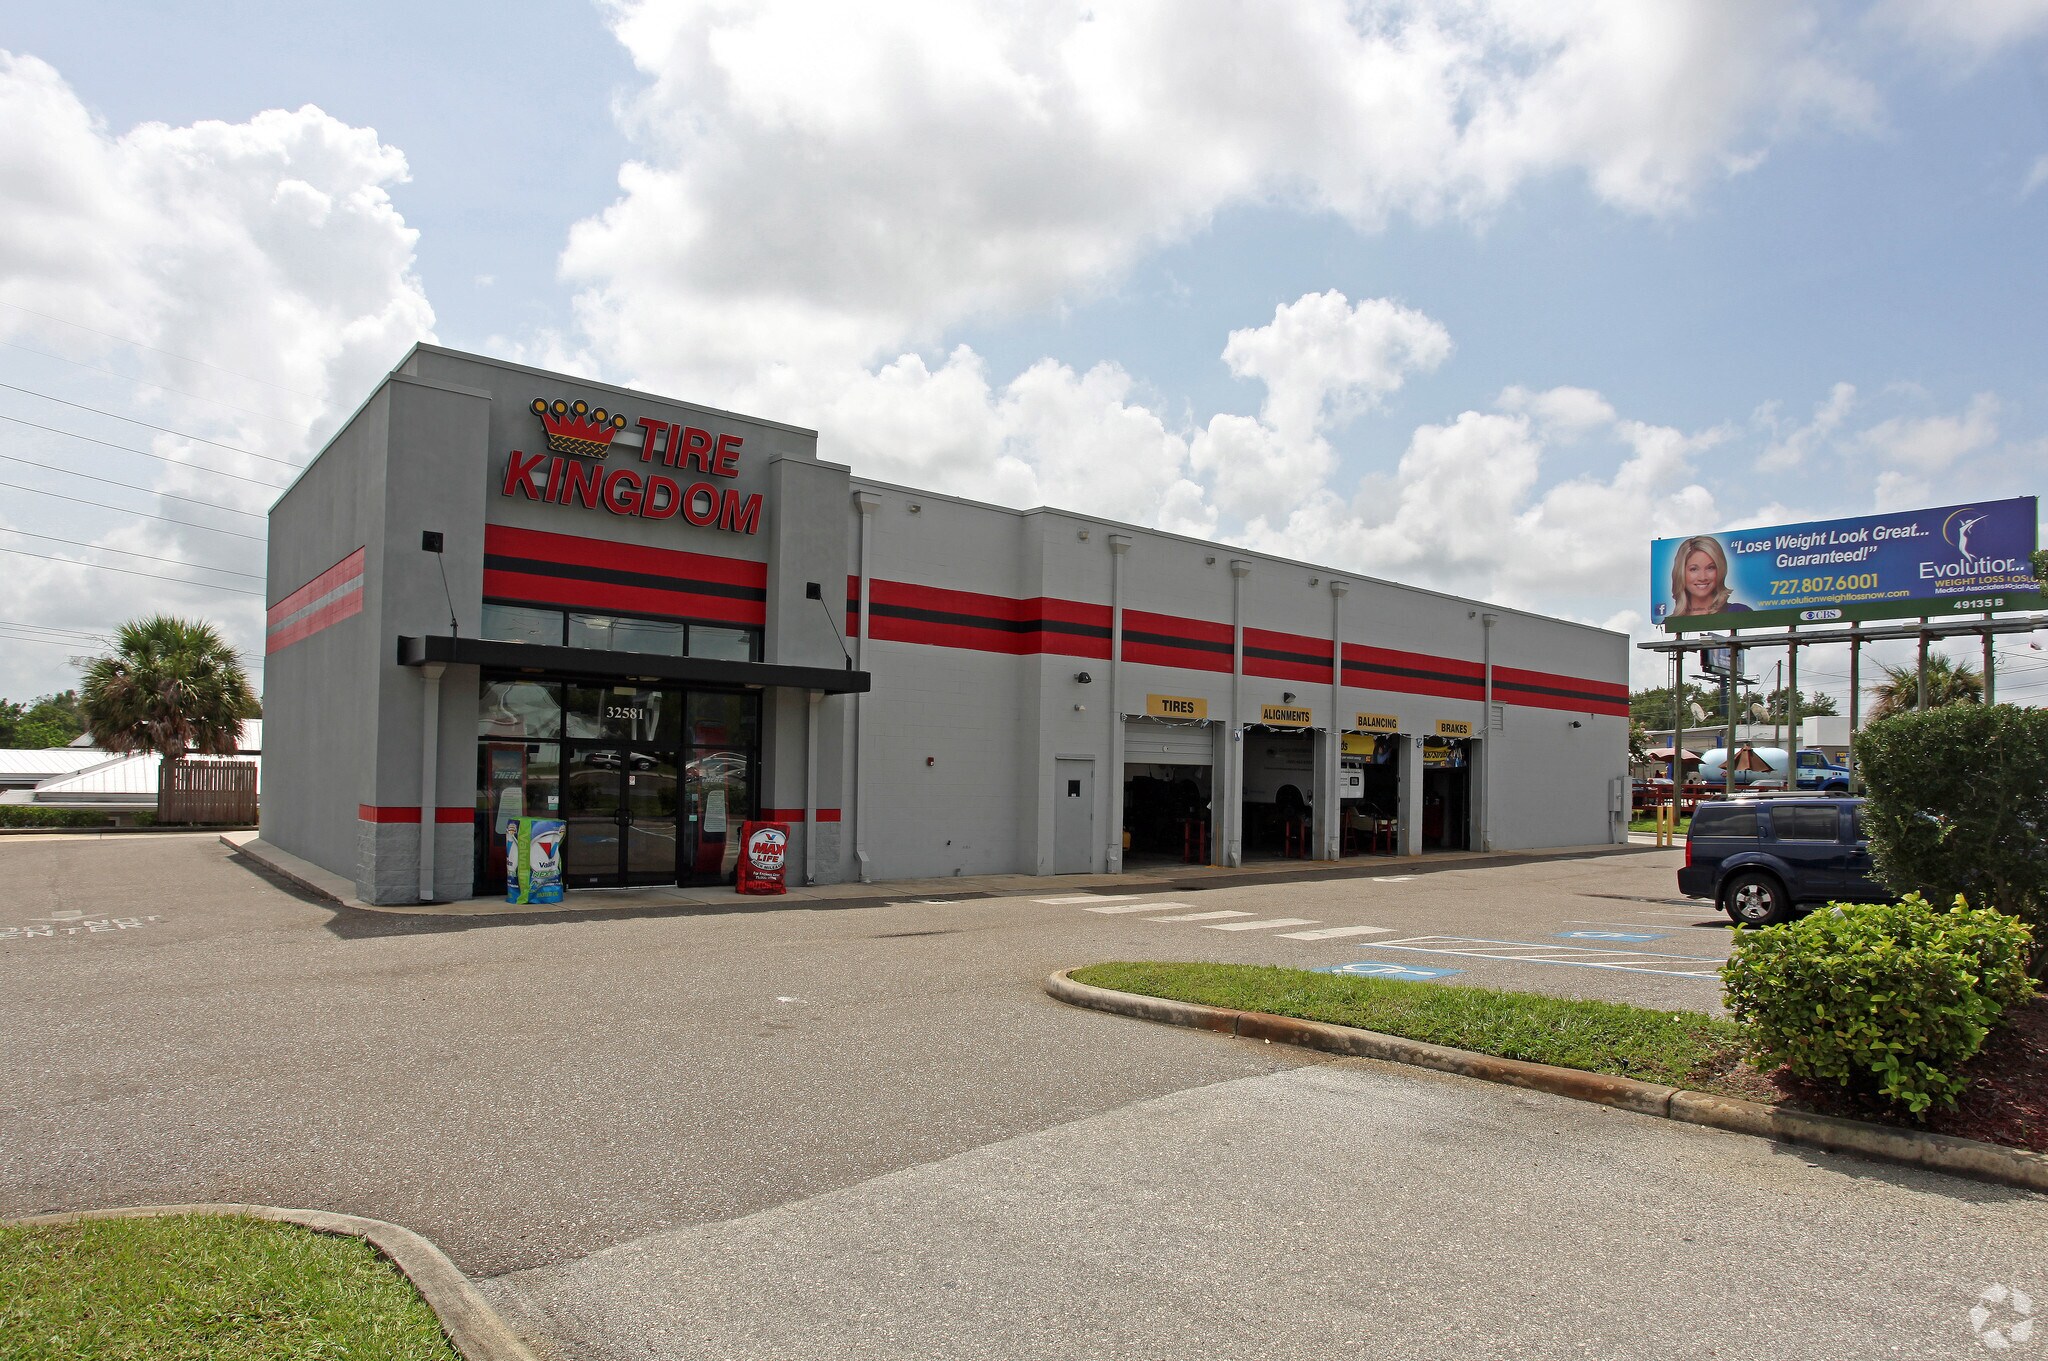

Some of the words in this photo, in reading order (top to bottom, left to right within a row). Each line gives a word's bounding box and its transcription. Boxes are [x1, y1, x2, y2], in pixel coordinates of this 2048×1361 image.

[637, 416, 744, 478] TIRE
[502, 450, 764, 535] KINGDOM
[1775, 532, 1826, 550] Weight
[1829, 528, 1868, 545] Look
[1872, 522, 1929, 541] Great...
[1770, 573, 1878, 595] 727.807.6001
[1935, 577, 1976, 587] WEIGHT
[1979, 575, 2004, 584] LOSS
[1935, 586, 1965, 594] Medical
[1757, 589, 1909, 607] www.evolutionweightlossnow.com
[1953, 599, 1992, 609] 49135
[1994, 598, 2004, 607] B
[1815, 610, 1836, 619] CBS
[1162, 699, 1194, 713] TIRES
[606, 706, 644, 720] 32581
[1263, 708, 1310, 722] ALIGNMENTS
[1358, 716, 1397, 728] BALANCING
[1441, 723, 1468, 734] BRAKES
[752, 842, 786, 855] MAX
[757, 855, 779, 863] LIFE
